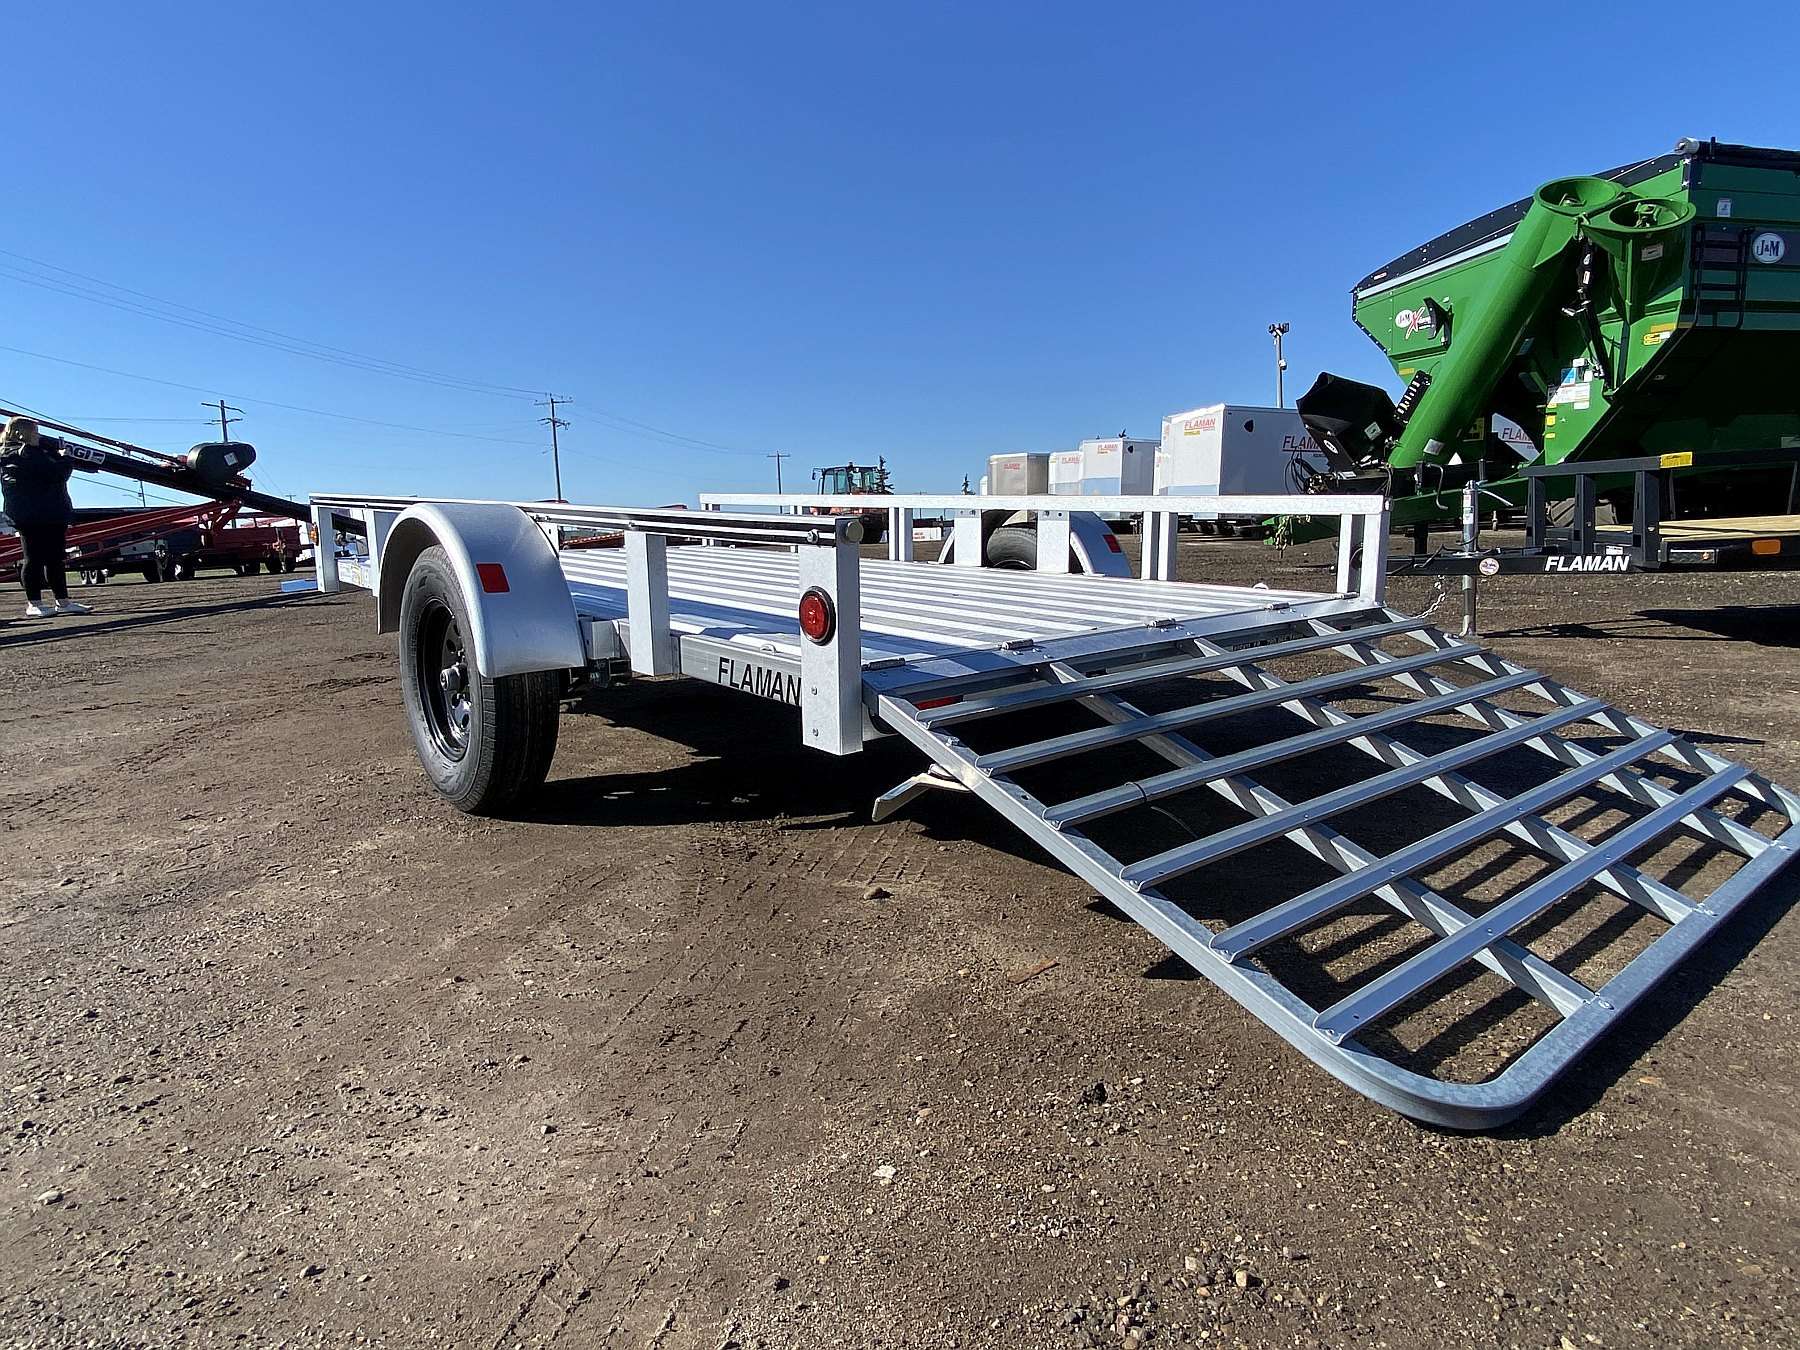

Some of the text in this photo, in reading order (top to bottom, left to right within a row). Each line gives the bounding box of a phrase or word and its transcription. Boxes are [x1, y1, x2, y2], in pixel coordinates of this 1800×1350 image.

[1756, 239, 1780, 257] J&M
[1184, 418, 1216, 429] FLAMAN
[1544, 555, 1630, 572] FLAMAN
[718, 656, 802, 706] FLAMAN
